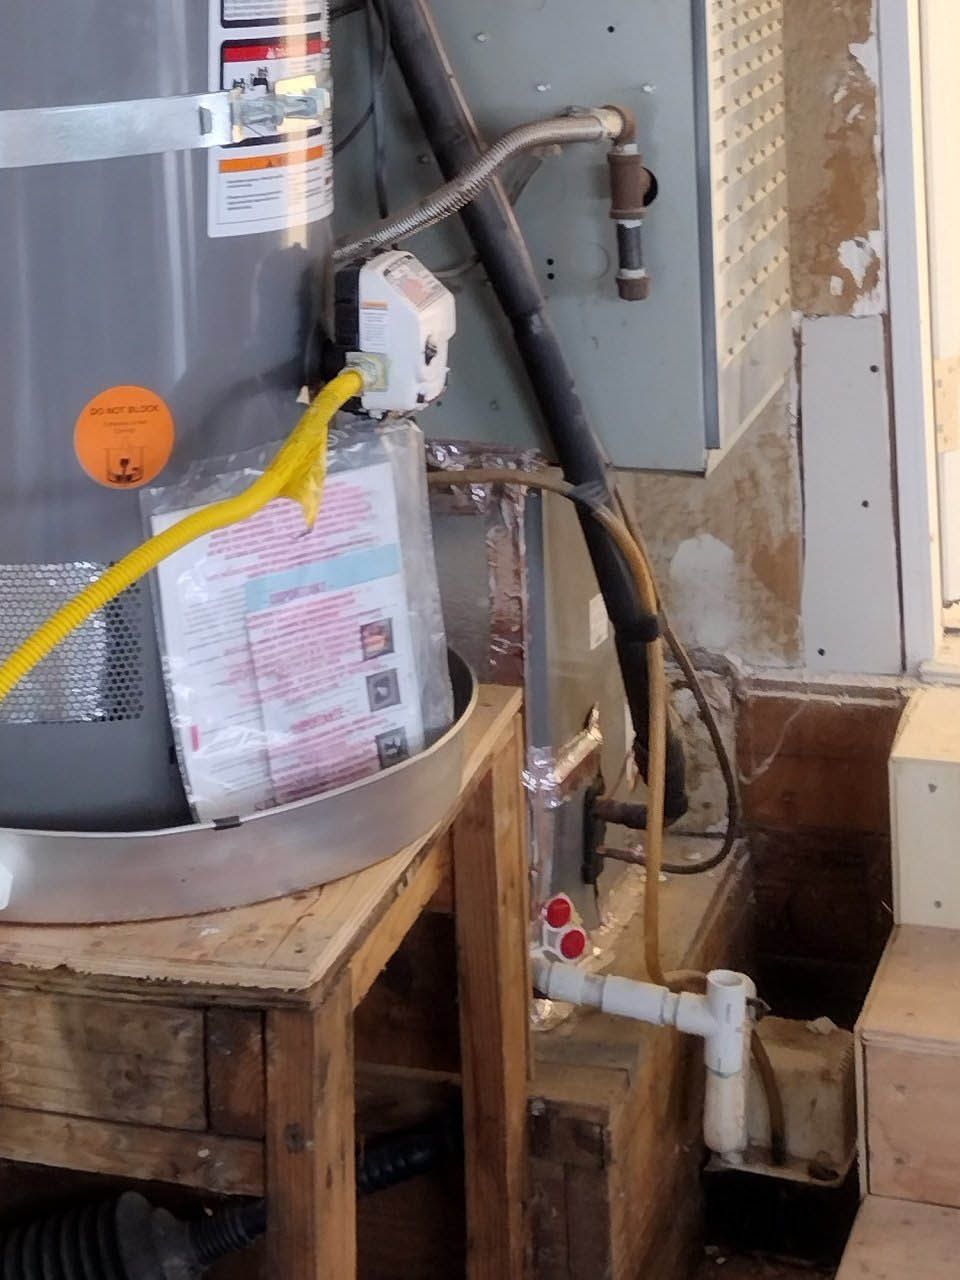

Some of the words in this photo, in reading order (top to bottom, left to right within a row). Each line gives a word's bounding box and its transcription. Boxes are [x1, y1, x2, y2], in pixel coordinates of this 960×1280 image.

[89, 407, 104, 416] DO
[106, 405, 125, 415] NOT
[127, 404, 159, 414] BLOCK
